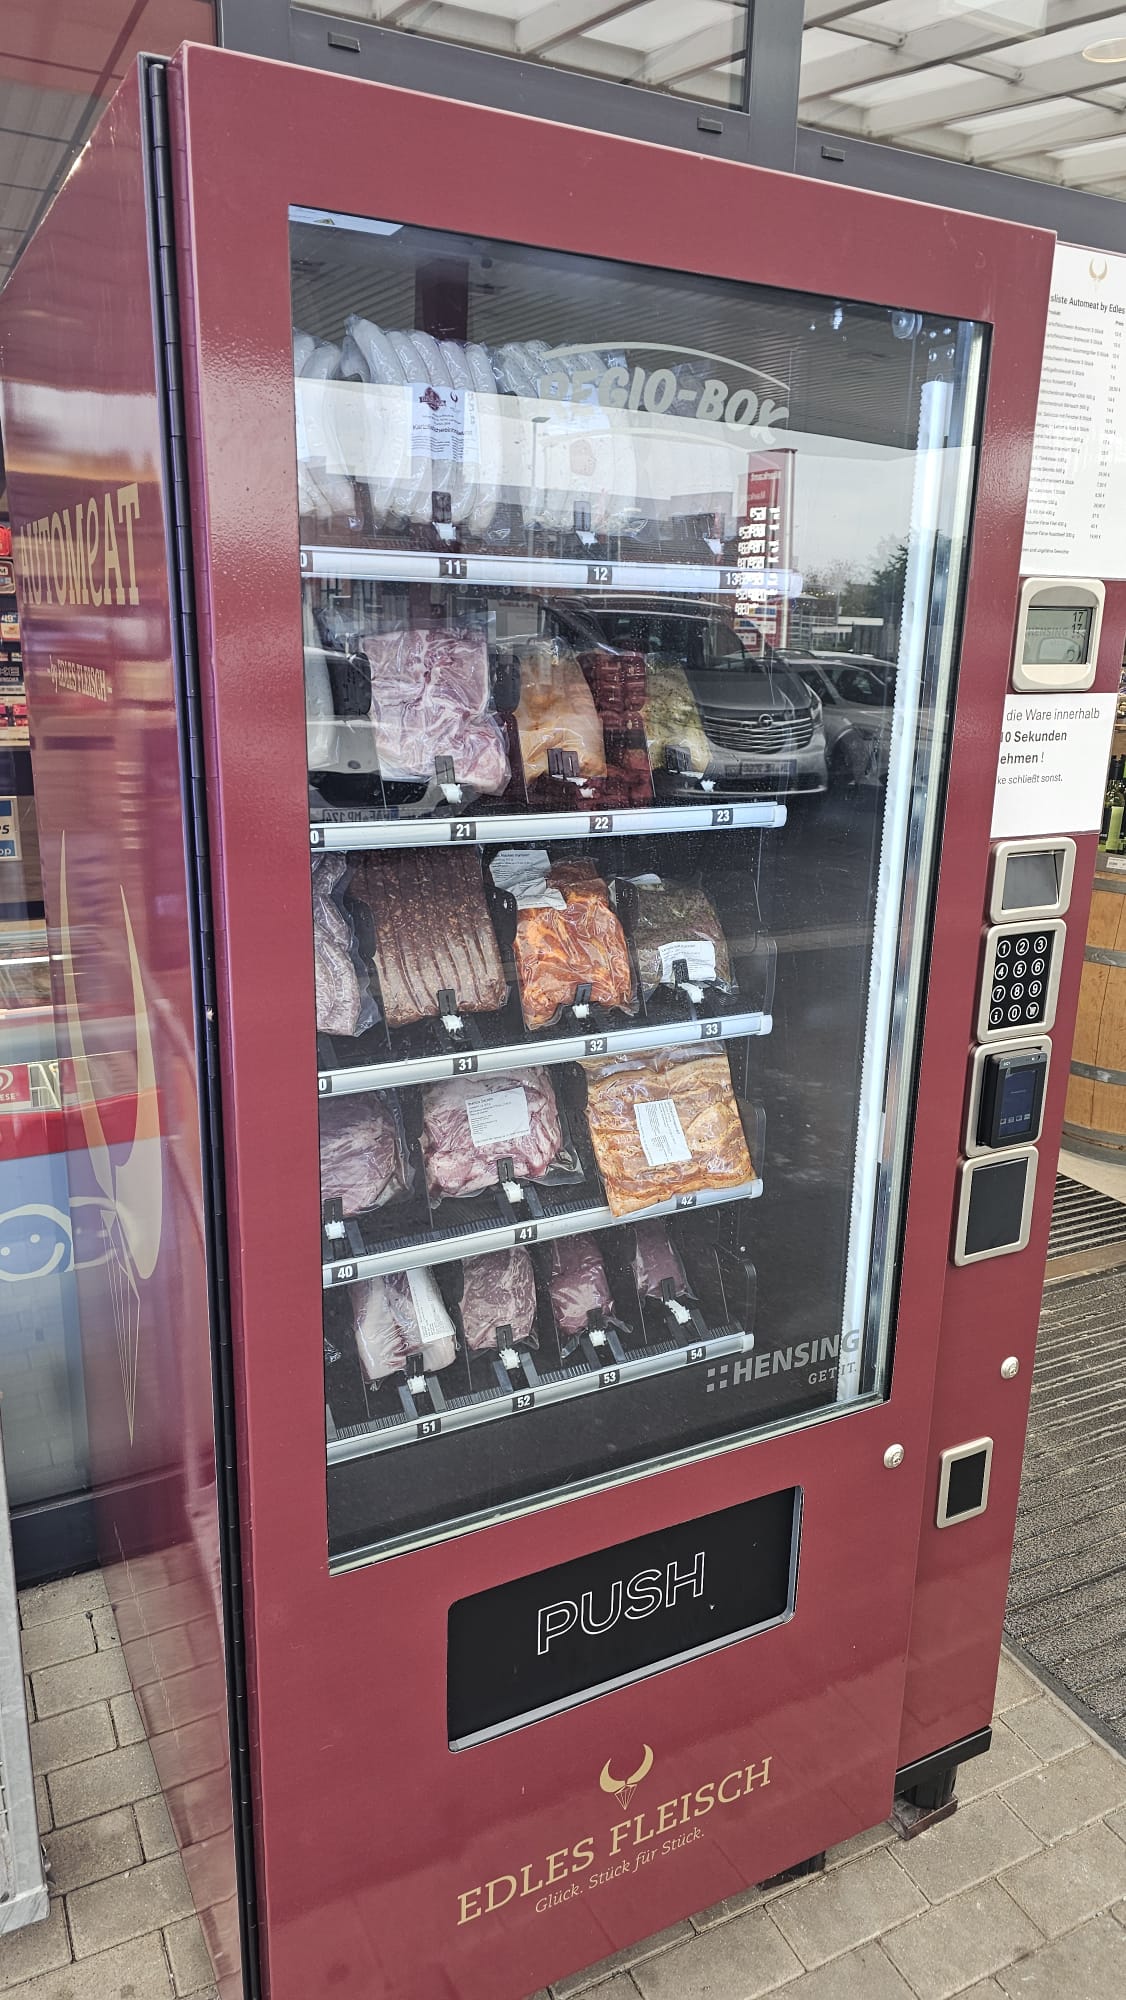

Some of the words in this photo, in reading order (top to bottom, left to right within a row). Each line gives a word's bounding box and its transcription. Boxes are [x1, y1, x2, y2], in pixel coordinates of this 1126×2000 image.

[1069, 297, 1099, 310] Automeat
[1100, 302, 1107, 314] by
[1108, 303, 1126, 315] Edles
[445, 559, 461, 575] 11
[593, 566, 608, 581] 12
[1073, 611, 1084, 623] 17
[1006, 709, 1023, 721] die
[1025, 708, 1052, 721] Ware
[1054, 707, 1100, 720] innerhalb
[1014, 730, 1067, 743] Sekunden
[1000, 753, 1039, 765] ehmen
[1040, 752, 1045, 763] !
[997, 776, 1007, 785] ke
[1008, 774, 1040, 785] schließt
[1040, 773, 1063, 783] sonst.
[717, 810, 730, 823] 23
[456, 823, 470, 837] 21
[594, 817, 609, 830] 22
[705, 1023, 718, 1036] 33
[591, 1039, 604, 1052] 32
[459, 1057, 472, 1071] 31
[681, 1195, 693, 1206] 42
[519, 1227, 532, 1240] 41
[337, 1265, 353, 1280] 40
[691, 1347, 703, 1360] 54
[733, 1330, 861, 1385] HENSING
[603, 1371, 616, 1384] 53
[808, 1366, 838, 1385] GET
[517, 1395, 531, 1408] 52
[422, 1420, 436, 1434] 51
[537, 1552, 705, 1656] PUSH
[456, 1836, 595, 1926] EDLES
[609, 1756, 773, 1857] FLEISCH
[535, 1883, 583, 1913] Glück.
[588, 1859, 631, 1890] Stück
[632, 1848, 659, 1873] für
[661, 1826, 705, 1856] Stück.
